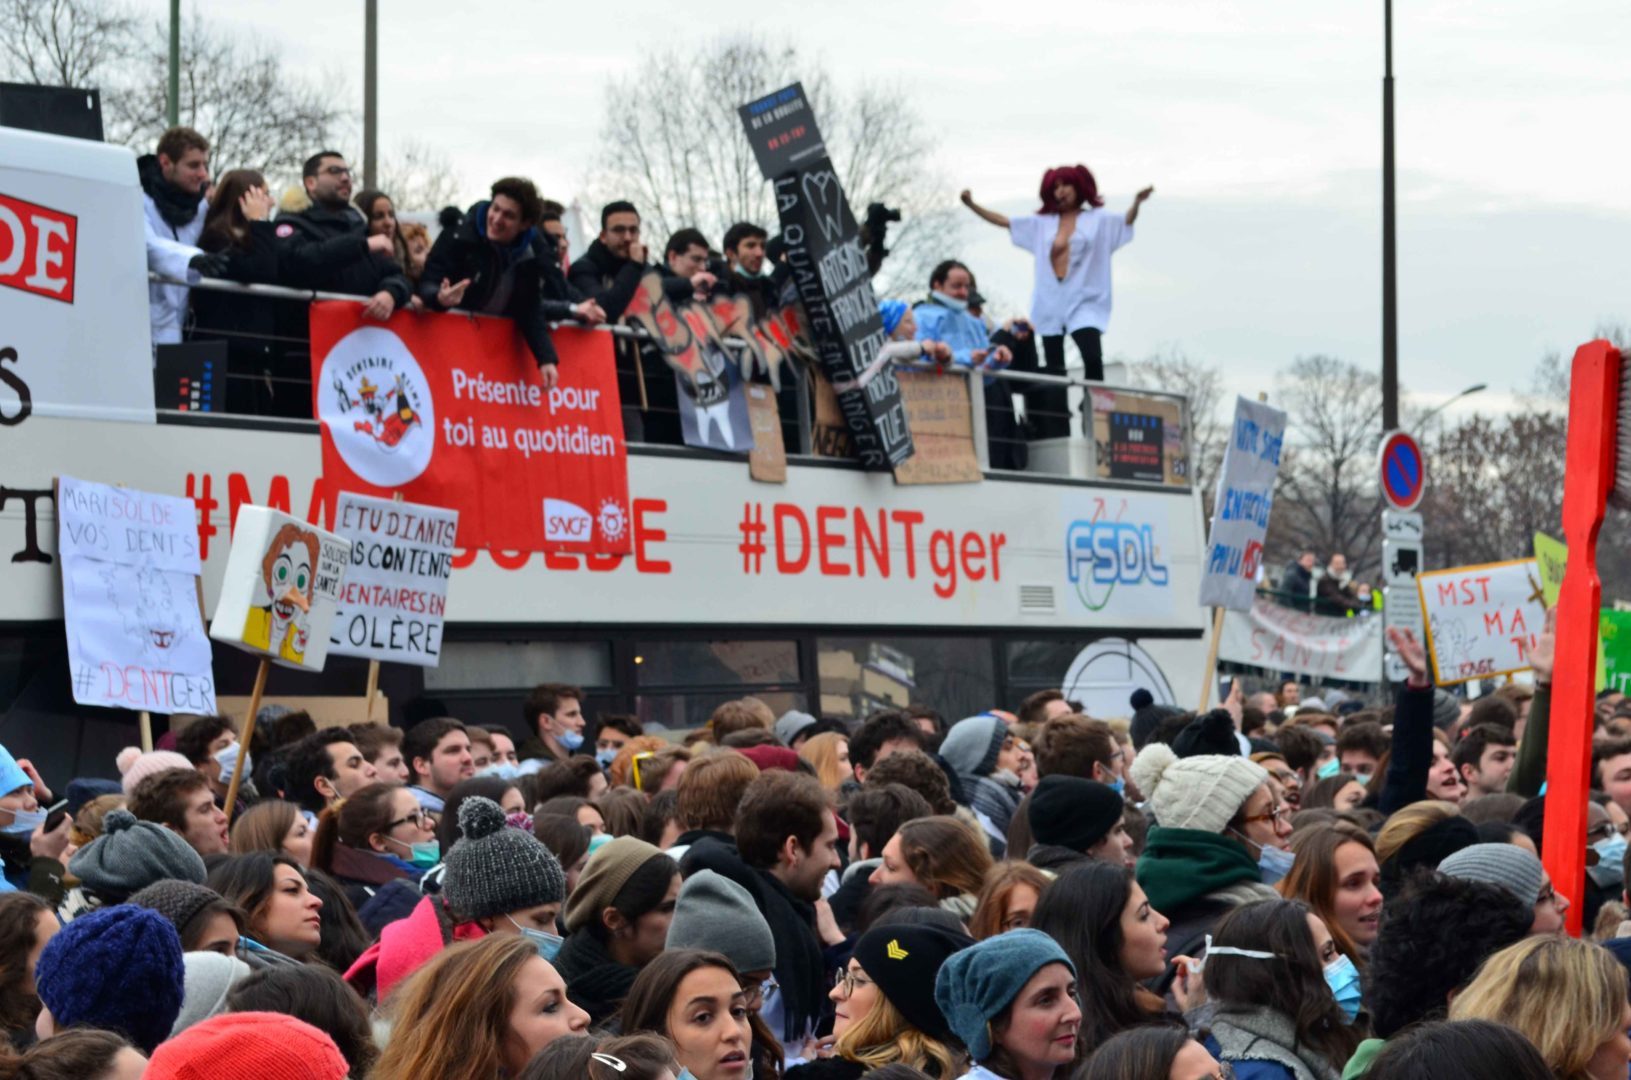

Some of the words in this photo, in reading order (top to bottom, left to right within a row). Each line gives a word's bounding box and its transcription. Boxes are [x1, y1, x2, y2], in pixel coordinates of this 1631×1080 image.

[774, 177, 799, 213] LA
[451, 367, 541, 406] Présente
[548, 385, 600, 415] pour
[443, 415, 476, 447] toi
[481, 424, 508, 449] au
[513, 423, 616, 459] quotidien
[66, 521, 109, 551] VOS
[126, 527, 195, 559] DENTS
[547, 515, 590, 536] SNCF
[367, 543, 453, 580] CONTENTS
[738, 500, 1007, 600] #DENTger
[1066, 519, 1168, 587] FSDL
[428, 593, 447, 617] EN
[1437, 577, 1492, 607] MST
[73, 660, 215, 713] #DENTGER
